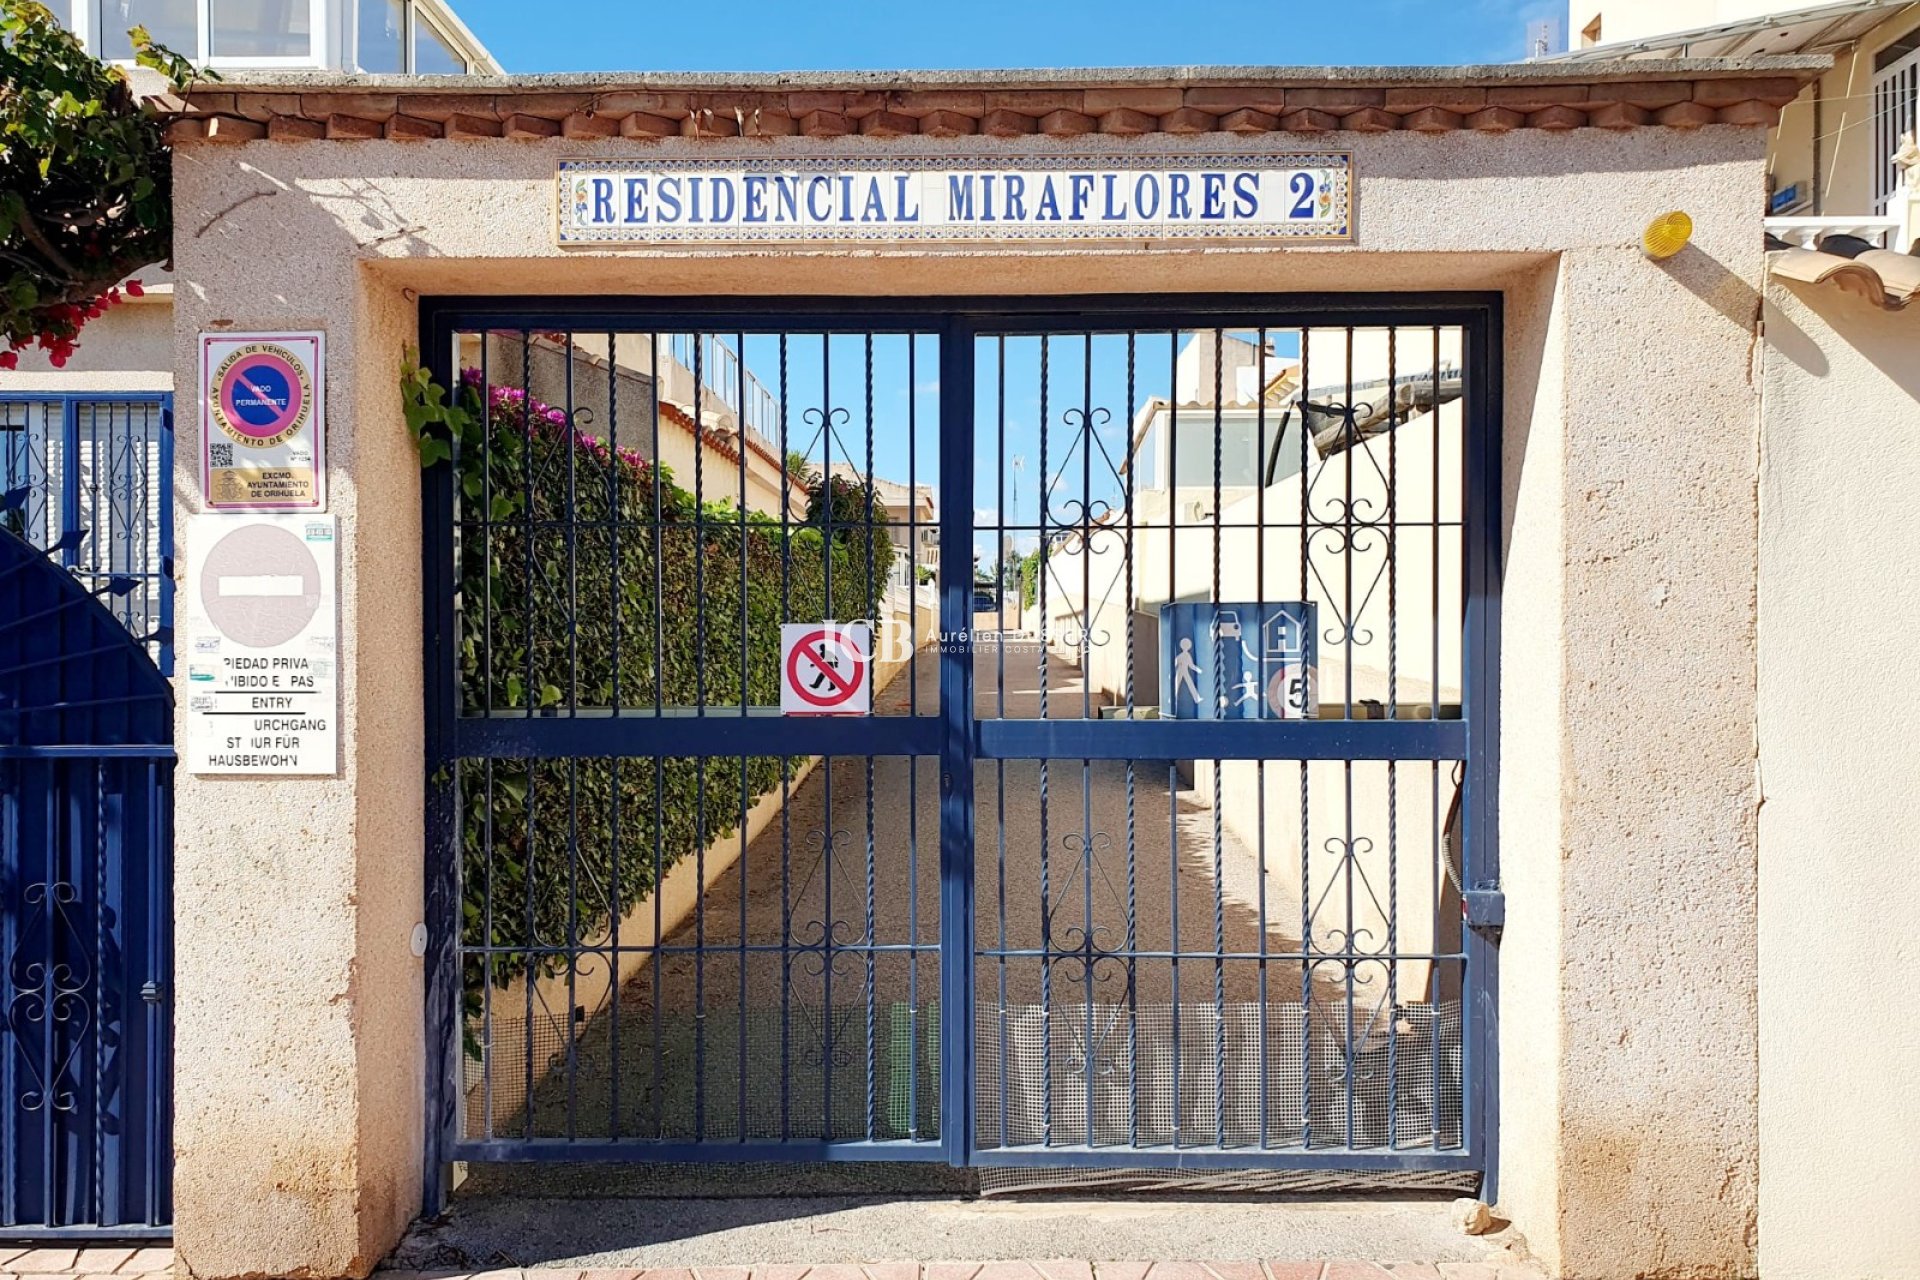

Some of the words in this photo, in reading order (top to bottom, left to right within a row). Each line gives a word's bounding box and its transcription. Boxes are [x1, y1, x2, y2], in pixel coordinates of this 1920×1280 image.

[592, 175, 919, 223] RESIDENCIAL
[948, 172, 1259, 222] MIRAFLORES
[1289, 172, 1315, 219] 2
[251, 385, 271, 393] VADO
[235, 398, 287, 407] PERMANENTE
[210, 386, 264, 447] AYUNTAMIENTO
[269, 435, 283, 445] DE
[286, 383, 311, 436] ORIHUELA
[262, 471, 294, 480] EXCMO.
[247, 480, 309, 489] AYUNTAMIENTO
[251, 489, 262, 498] DE
[264, 489, 306, 498] ORIHUELA
[291, 675, 315, 687] PAS
[1288, 678, 1304, 709] 5
[251, 697, 293, 709] ENTRY
[253, 719, 327, 731] URCHGANG
[275, 734, 300, 749] FÜR
